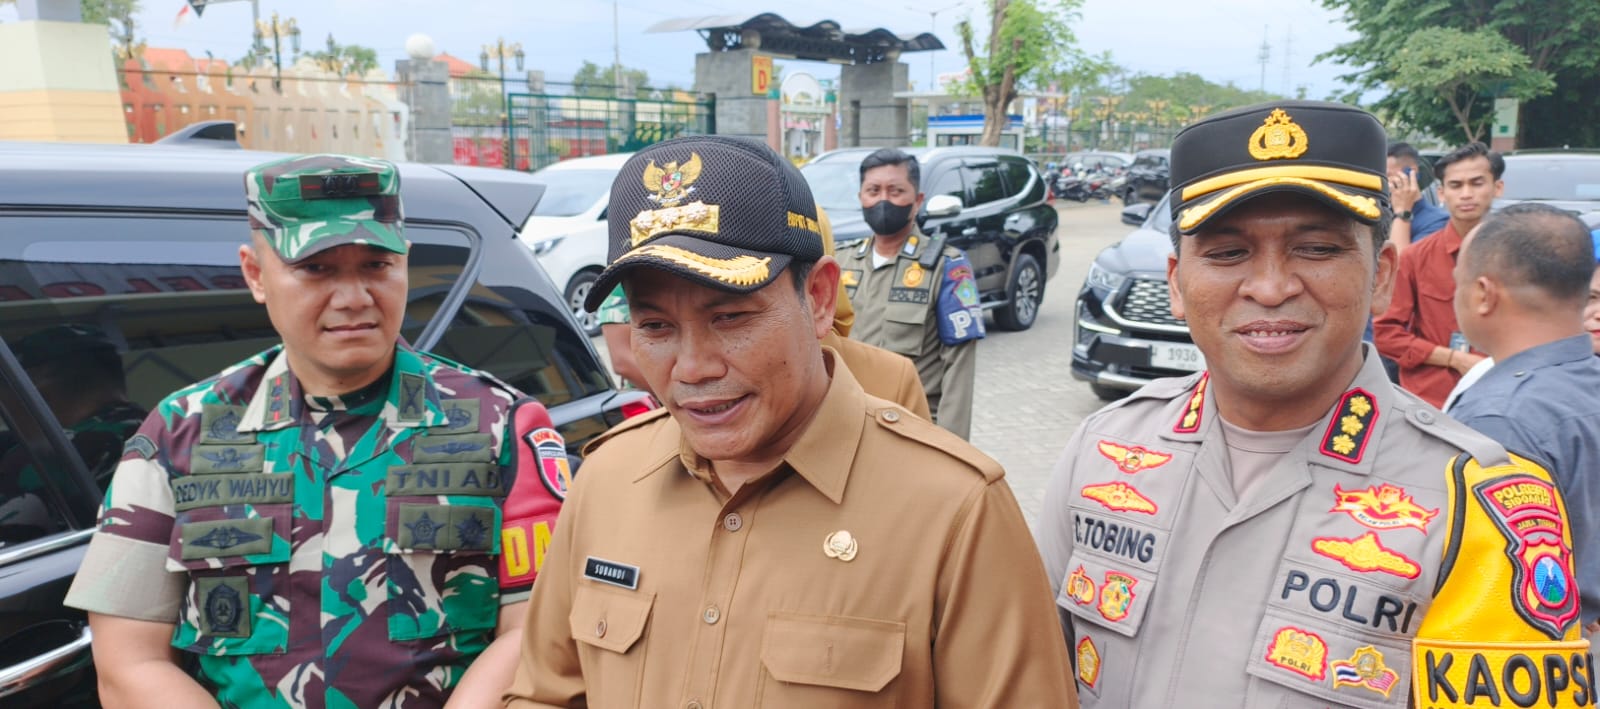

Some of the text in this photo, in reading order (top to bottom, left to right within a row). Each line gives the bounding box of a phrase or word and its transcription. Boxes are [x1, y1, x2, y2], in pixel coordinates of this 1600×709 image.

[758, 69, 768, 92] D
[890, 289, 928, 303] POL PP
[1168, 347, 1197, 362] 1936
[229, 477, 290, 497] WAHYU
[392, 469, 498, 489] TNI AD
[595, 564, 626, 580] SUBANDI
[1281, 569, 1417, 634] POLRI
[1280, 656, 1311, 672] POLRI
